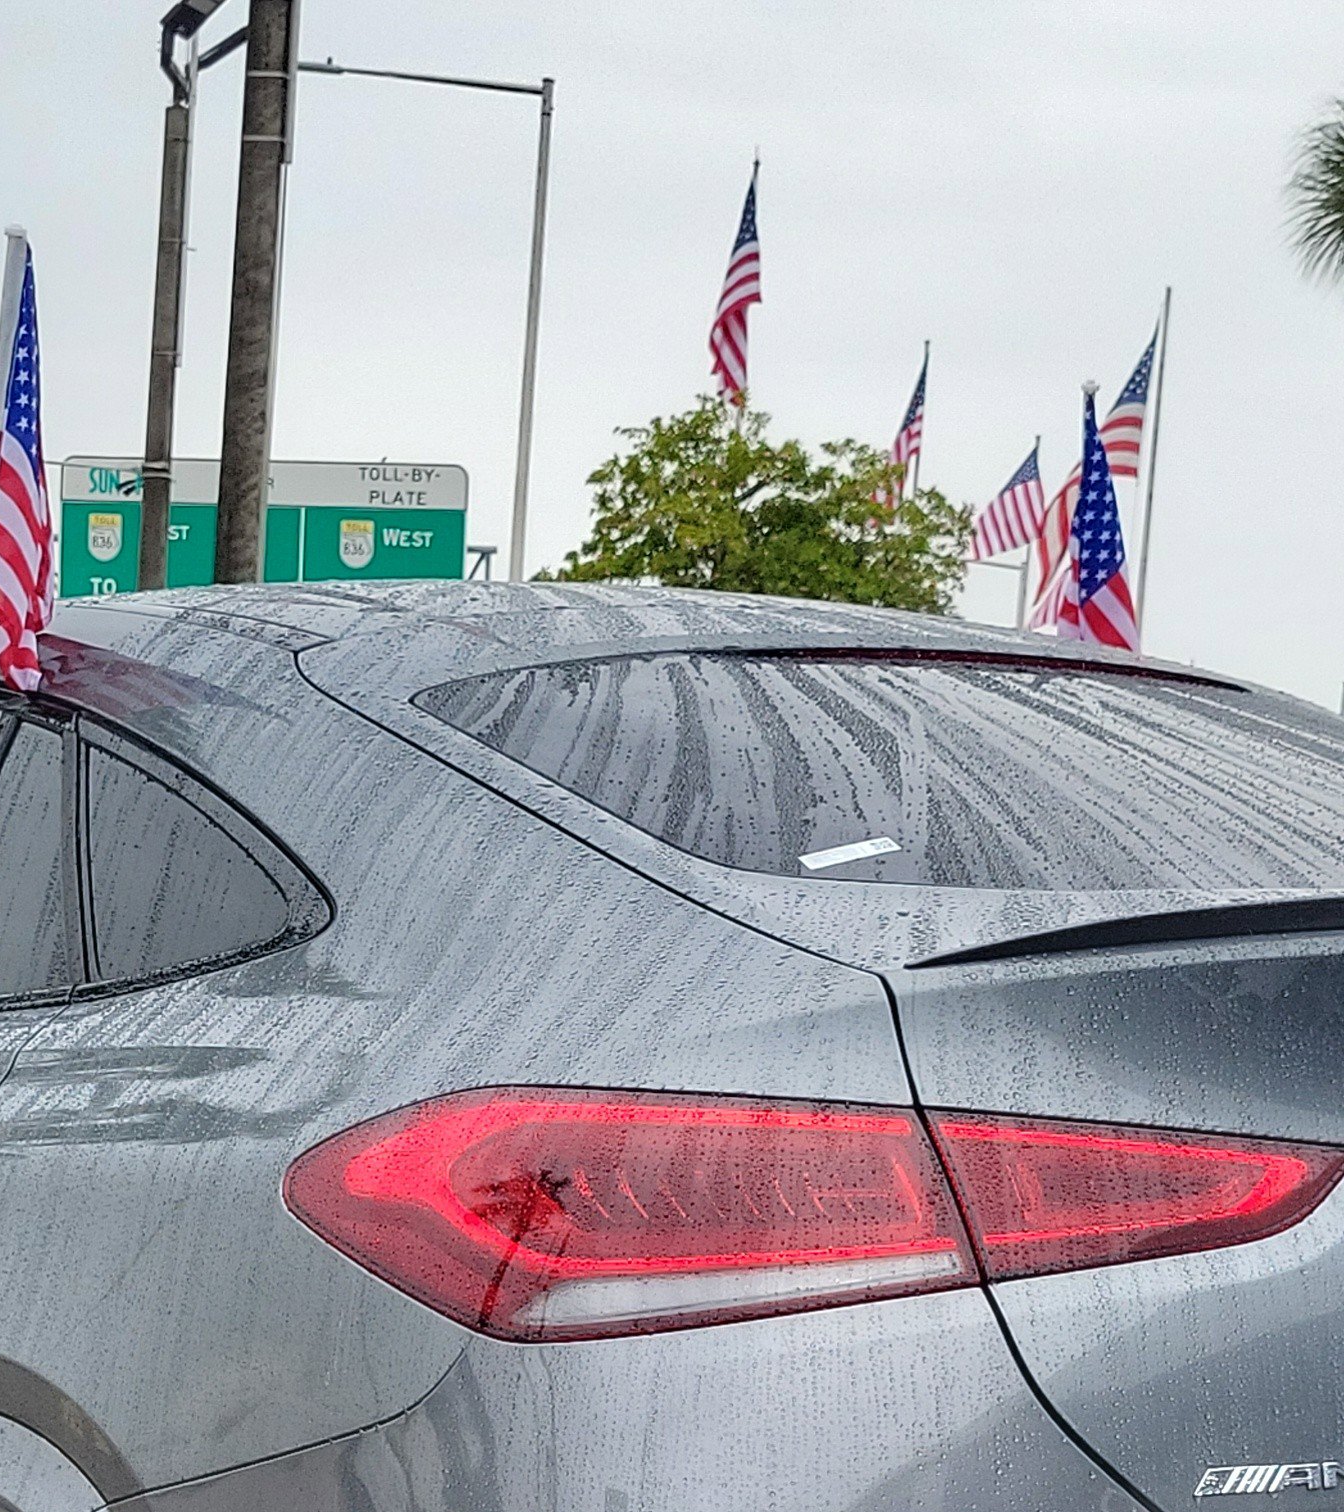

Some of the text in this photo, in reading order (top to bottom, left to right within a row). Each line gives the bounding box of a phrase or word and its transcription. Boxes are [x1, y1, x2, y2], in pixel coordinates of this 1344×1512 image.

[358, 466, 442, 483] TOLL-BY-
[368, 490, 428, 506] PLATE
[167, 524, 190, 541] ST
[382, 527, 434, 548] WEST
[89, 577, 118, 595] TO
